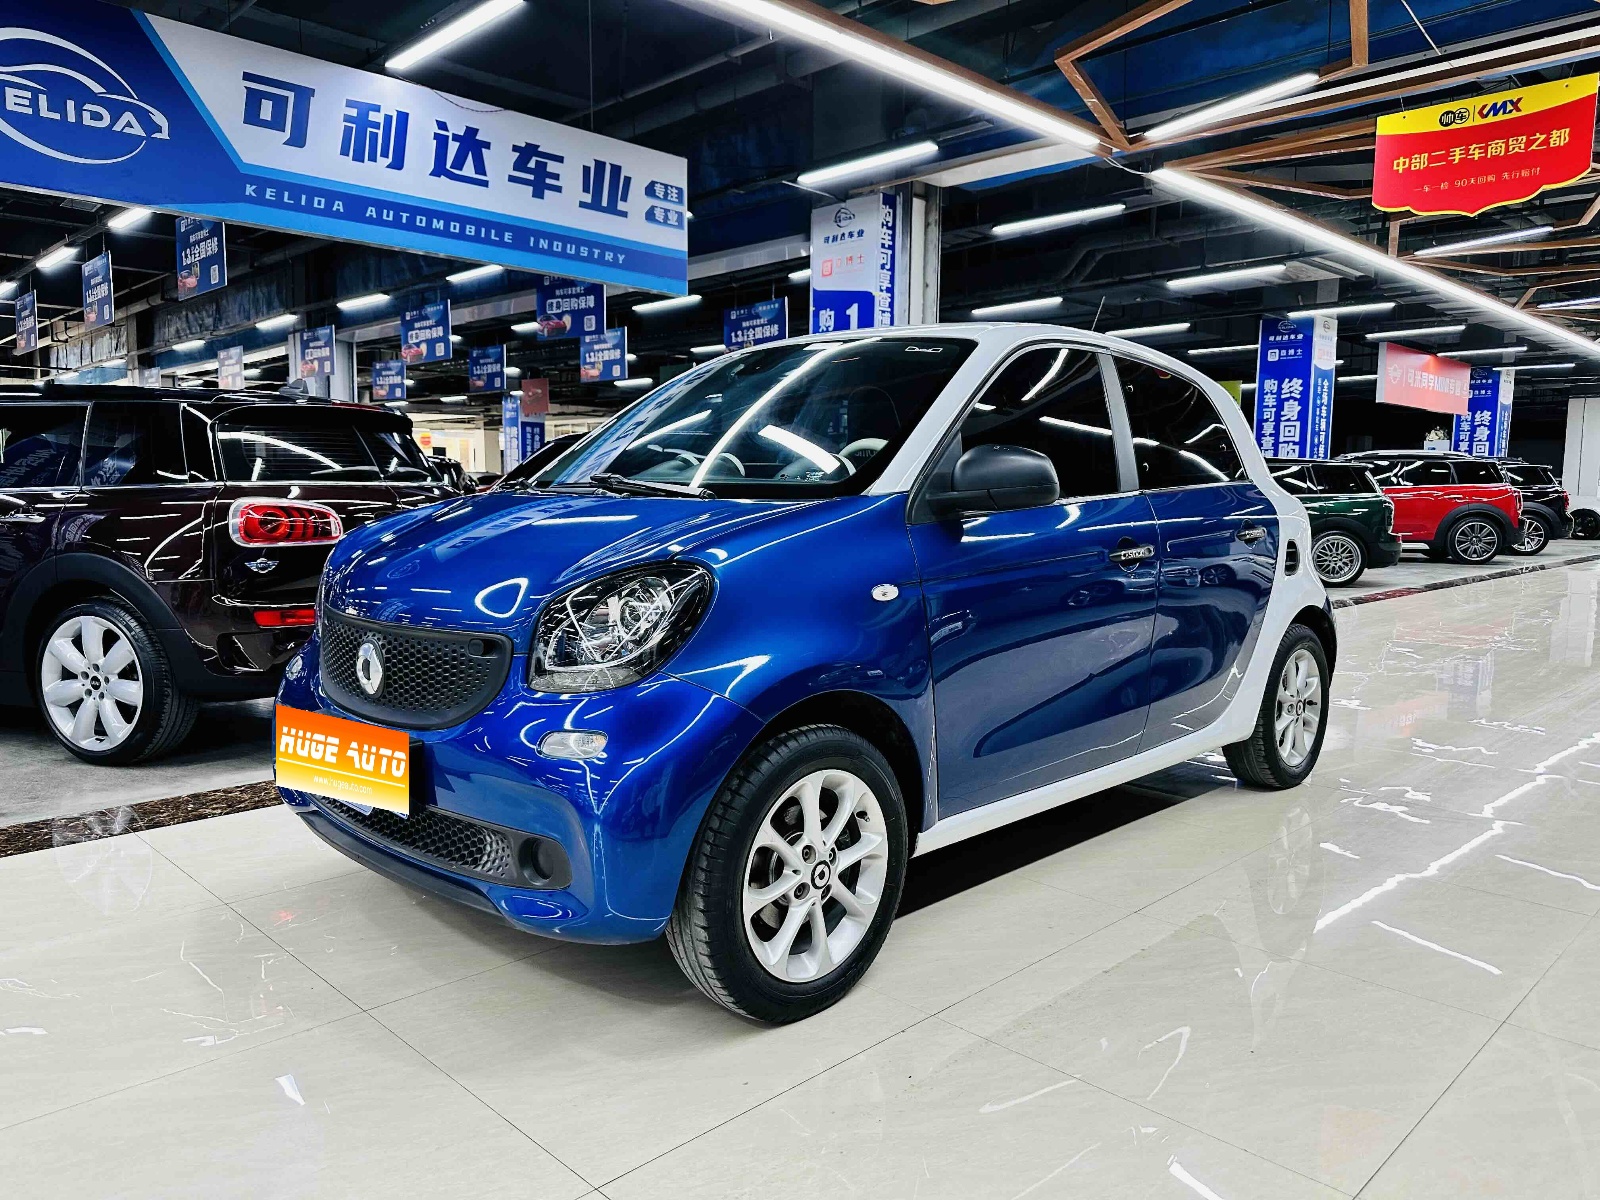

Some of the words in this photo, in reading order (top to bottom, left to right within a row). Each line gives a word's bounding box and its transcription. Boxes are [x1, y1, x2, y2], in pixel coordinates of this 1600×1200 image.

[241, 71, 631, 218] 可利达车业
[1393, 127, 1571, 174] 中部二手车商贸之都
[1454, 174, 1496, 188] 90天回购
[1501, 167, 1540, 181] 先行赔付
[654, 183, 679, 202] 专注
[245, 184, 344, 213] KELIDA
[366, 206, 513, 244] AUTOMOBILE
[529, 236, 626, 265] INDUSTRY
[654, 207, 679, 226] 专业
[819, 308, 835, 332] 购
[846, 302, 858, 331] 1
